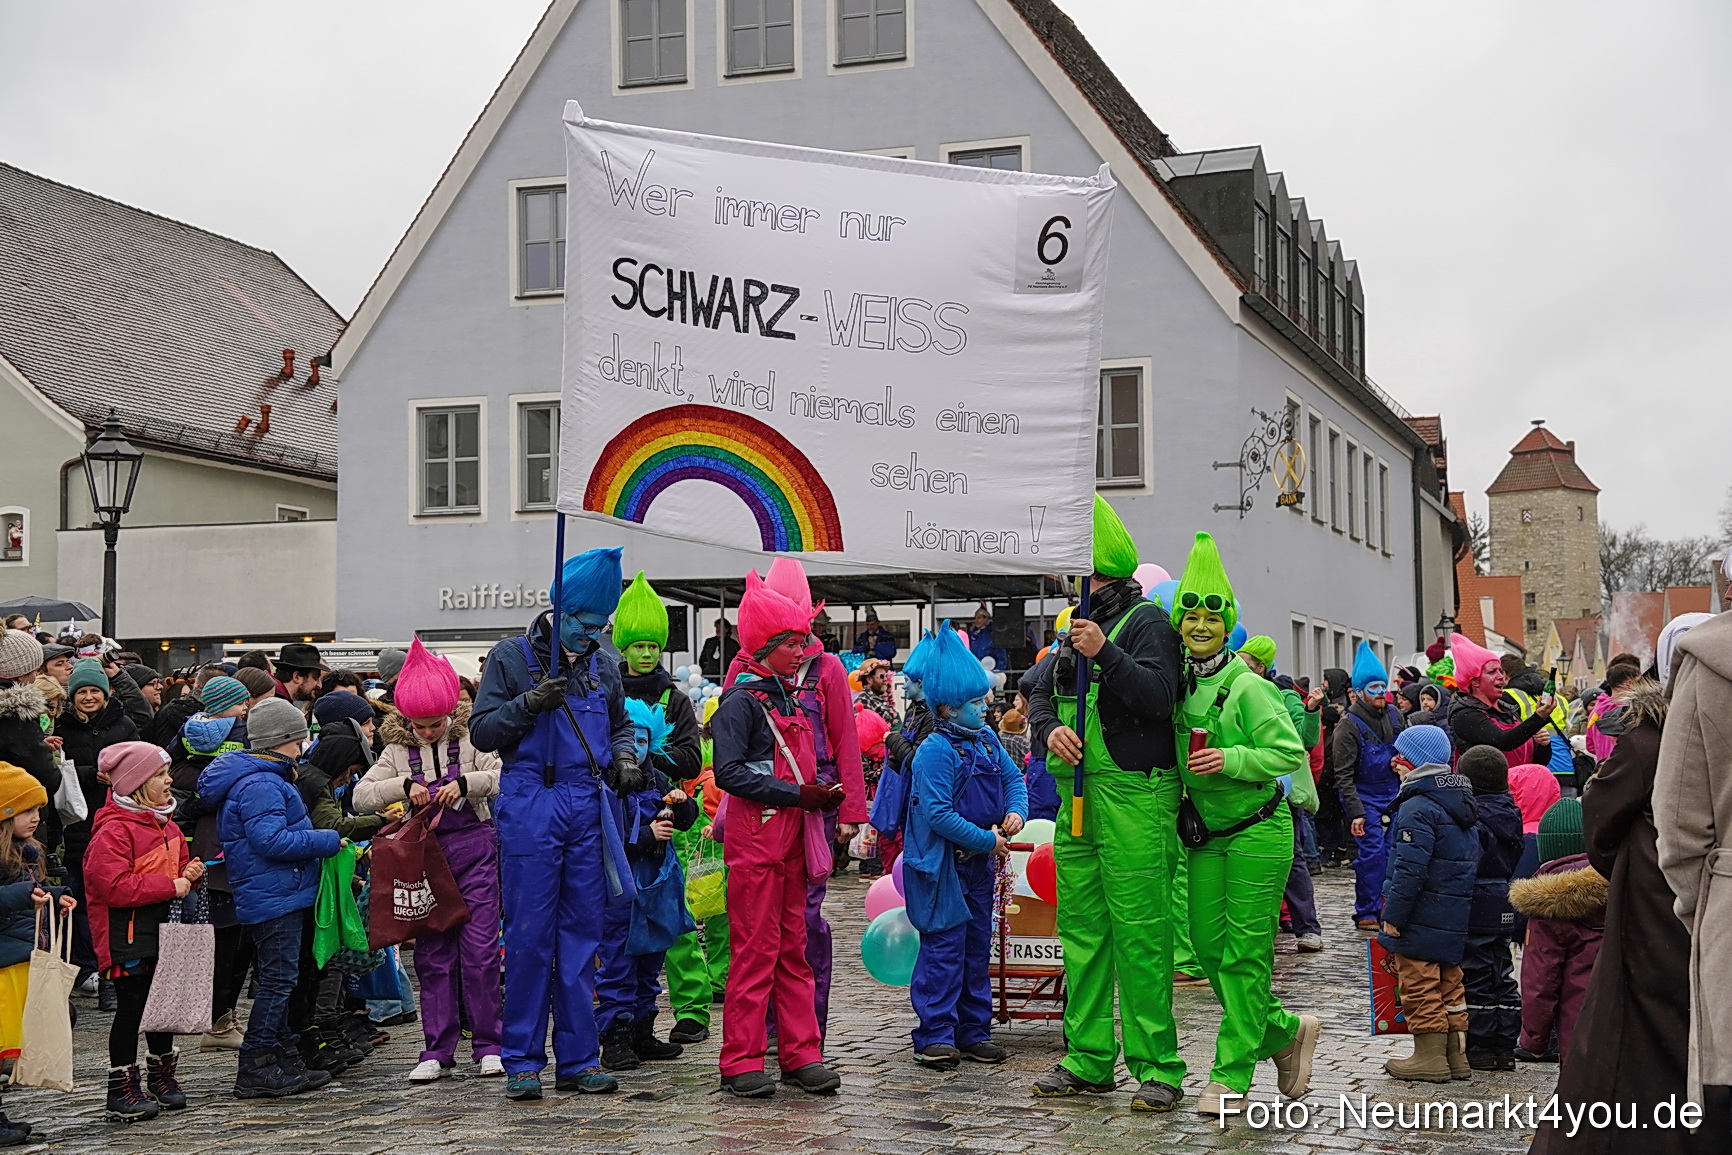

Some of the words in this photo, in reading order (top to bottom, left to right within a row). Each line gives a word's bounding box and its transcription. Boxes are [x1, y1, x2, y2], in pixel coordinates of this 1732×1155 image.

[600, 148, 694, 217] Wer
[714, 185, 820, 233] immer
[839, 208, 906, 241] nur
[1037, 215, 1071, 266] 6
[610, 257, 970, 356] SCHWARZ-WEISS
[597, 332, 695, 402] denkt,
[707, 370, 776, 412] wird
[789, 385, 916, 429] niemals
[935, 401, 1020, 434] einen
[869, 451, 968, 494] sehen
[905, 510, 1020, 554] können
[439, 583, 550, 610] Raiffeise
